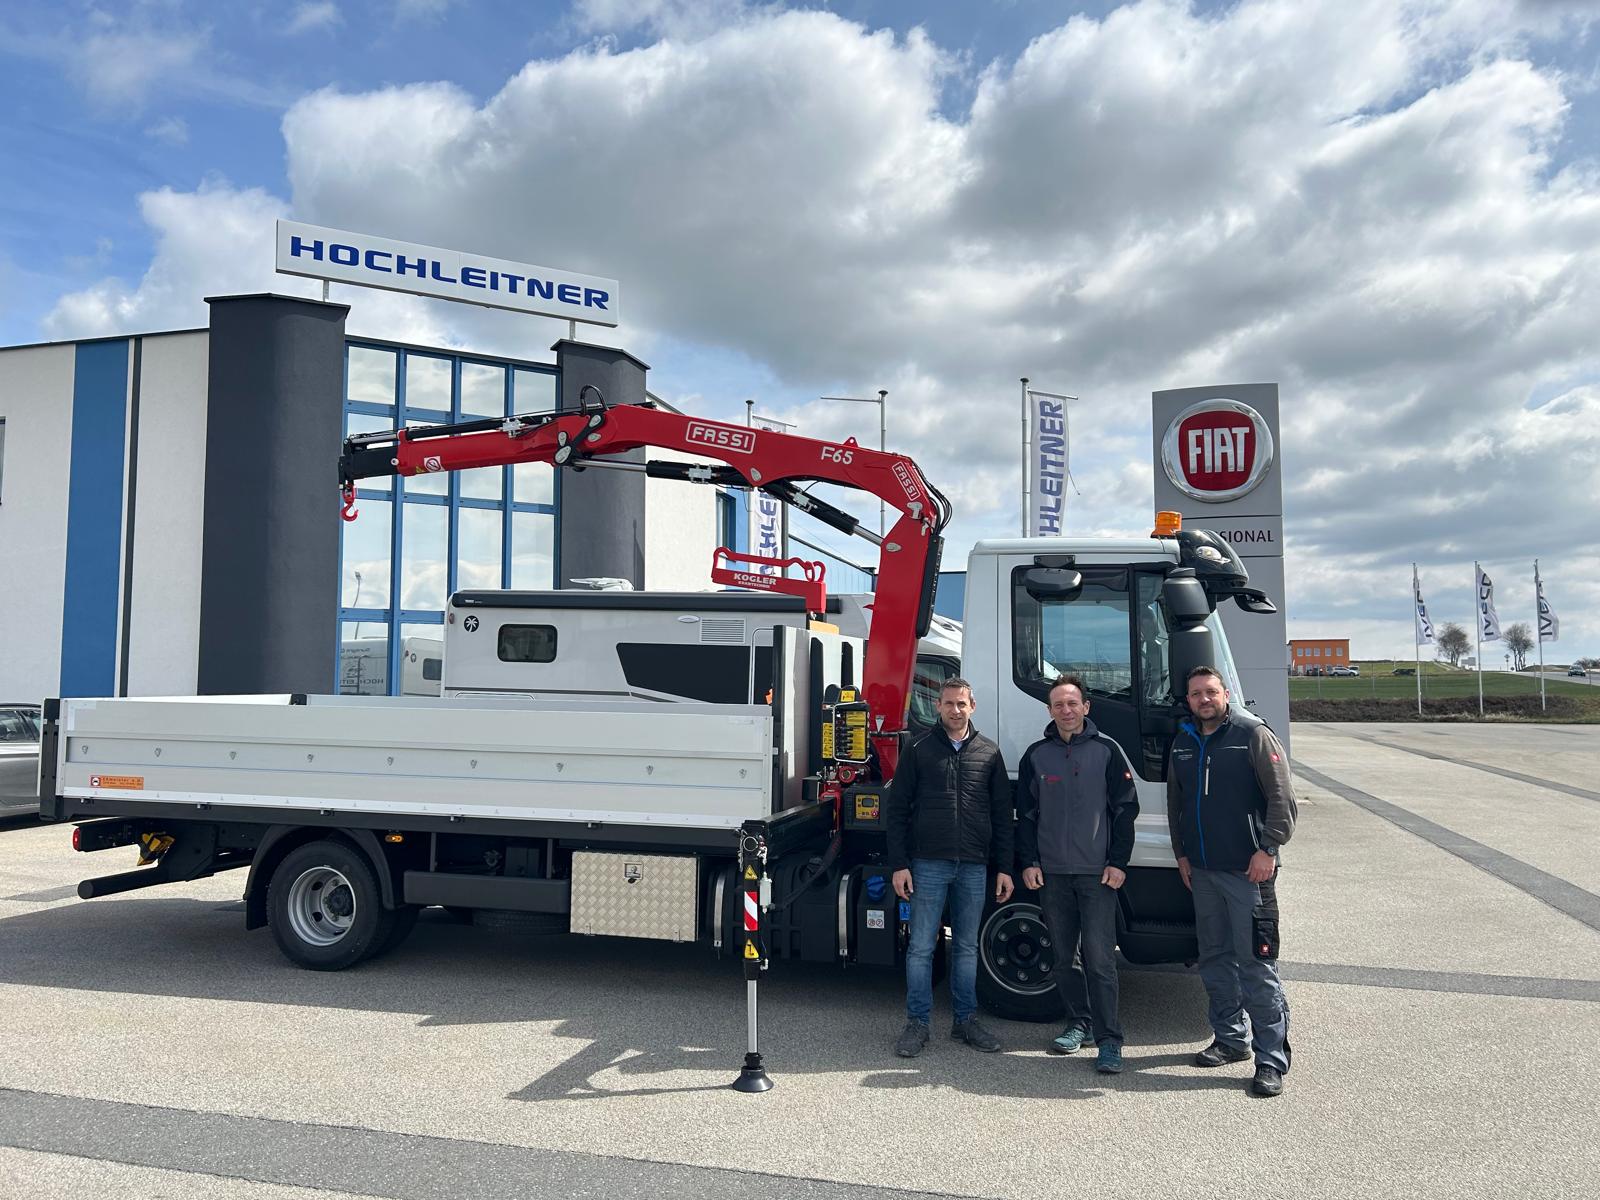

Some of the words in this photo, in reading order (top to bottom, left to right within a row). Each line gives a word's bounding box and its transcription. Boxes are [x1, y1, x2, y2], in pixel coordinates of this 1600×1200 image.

[290, 236, 609, 311] HOCHLEITNER
[692, 426, 749, 449] FASSI
[1188, 426, 1249, 474] FIAT
[820, 446, 854, 465] F65
[1039, 400, 1065, 537] HLEITNER
[894, 465, 918, 499] FASSI
[1219, 530, 1274, 543] SIONAL
[733, 573, 777, 586] KOGLER
[1480, 573, 1494, 636] IVECO
